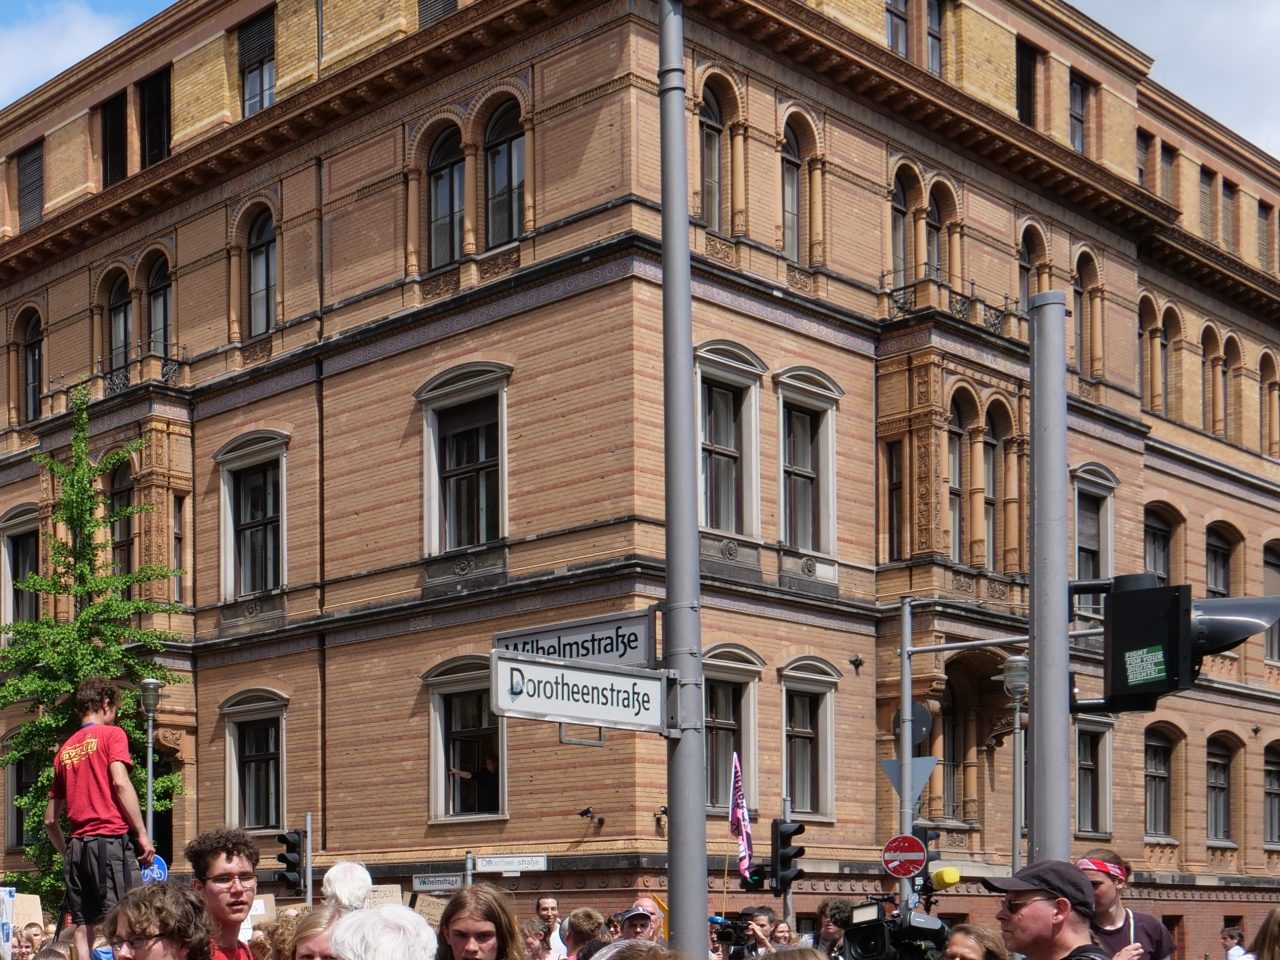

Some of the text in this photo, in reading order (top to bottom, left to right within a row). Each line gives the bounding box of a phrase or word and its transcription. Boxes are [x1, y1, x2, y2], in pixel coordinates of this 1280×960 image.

[1125, 649, 1148, 658] FIGHT
[1143, 653, 1164, 662] YOUR
[1127, 662, 1157, 672] DIGITAL
[509, 667, 651, 717] Dorotheenstraße
